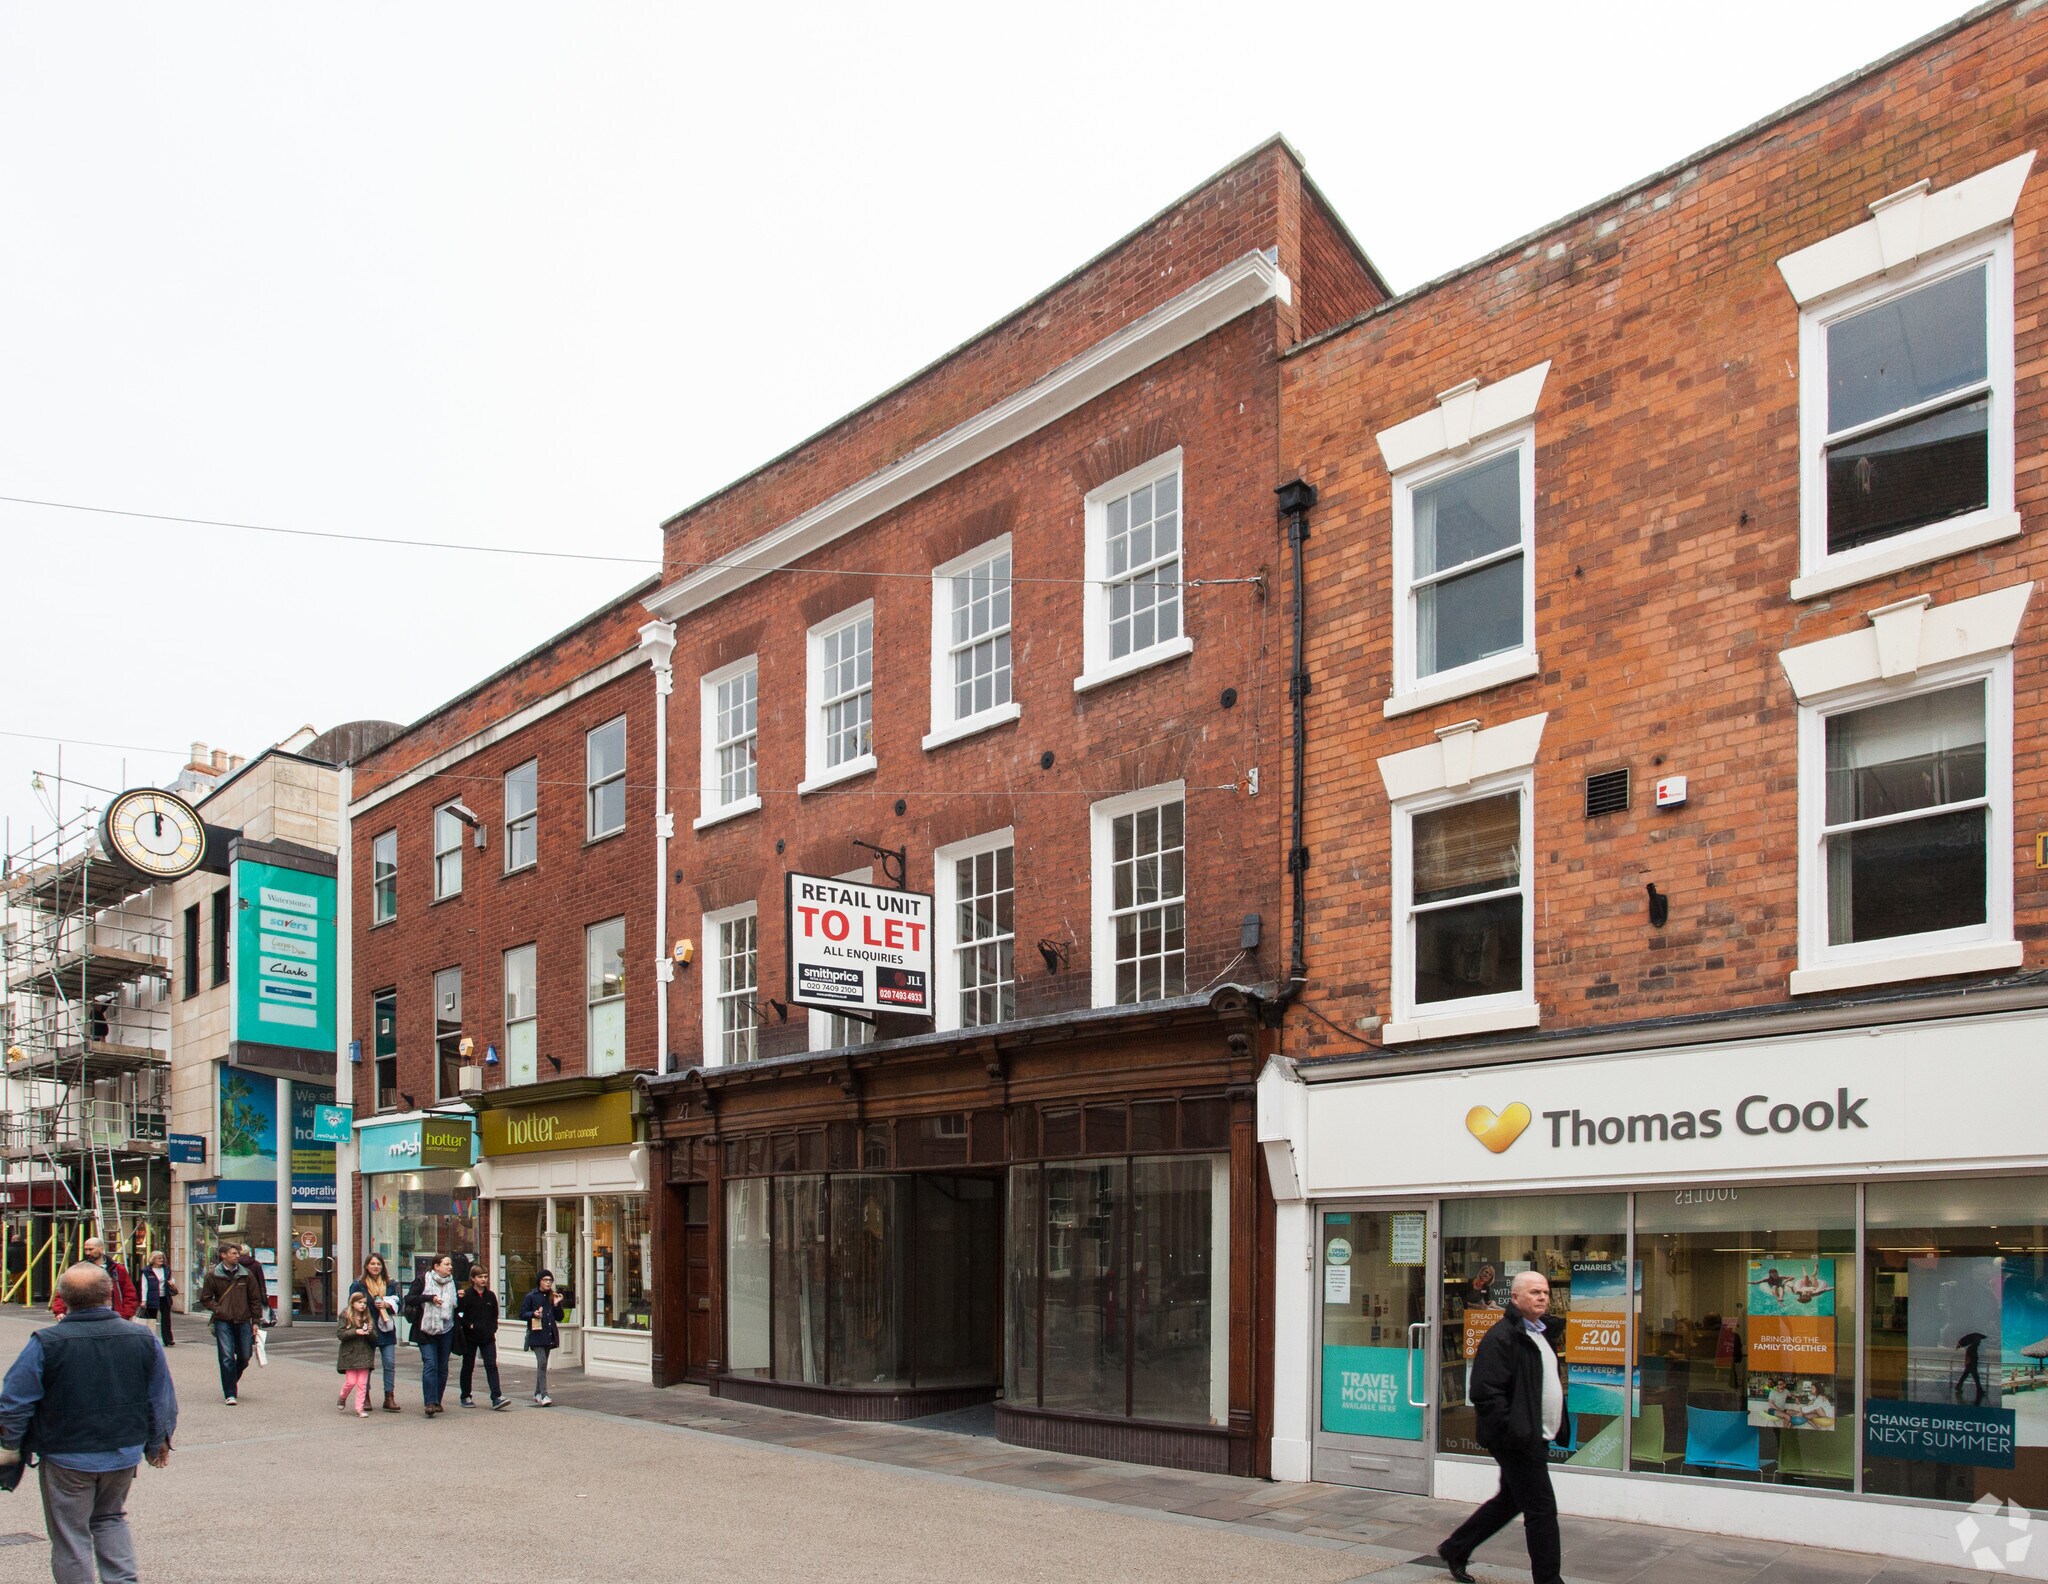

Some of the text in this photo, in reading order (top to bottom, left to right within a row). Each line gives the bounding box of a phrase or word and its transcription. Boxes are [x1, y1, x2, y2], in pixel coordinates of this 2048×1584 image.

[268, 894, 311, 908] Waterstones
[802, 883, 920, 915] RETAIL UNIT
[270, 920, 308, 930] savers
[798, 906, 926, 951] TO LET
[824, 946, 903, 964] ALL ENQUIRIES
[270, 963, 308, 977] Clarks
[804, 968, 858, 983] smithprice
[907, 976, 922, 986] JLL
[880, 990, 891, 998] 020
[296, 1090, 334, 1101] We se
[302, 1107, 313, 1118] ki
[1543, 1088, 1868, 1147] Thomas Cook
[296, 1126, 314, 1139] ho
[508, 1113, 559, 1145] hotter
[577, 1127, 598, 1139] concept
[388, 1132, 421, 1156] mosh
[426, 1133, 466, 1146] hotter
[292, 1186, 336, 1197] o-operativ
[1581, 1330, 1620, 1345] £200
[1804, 1336, 1819, 1344] THE
[1782, 1344, 1827, 1352] TOGETHER
[1342, 1371, 1398, 1389] TRAVEL
[1342, 1387, 1398, 1403] MONEY
[1342, 1402, 1375, 1410] AVAILABLE
[1869, 1414, 2010, 1435] CHANGE DIRECTION
[1446, 1437, 1457, 1448] to
[1869, 1427, 2010, 1453] NEXT SUMMER
